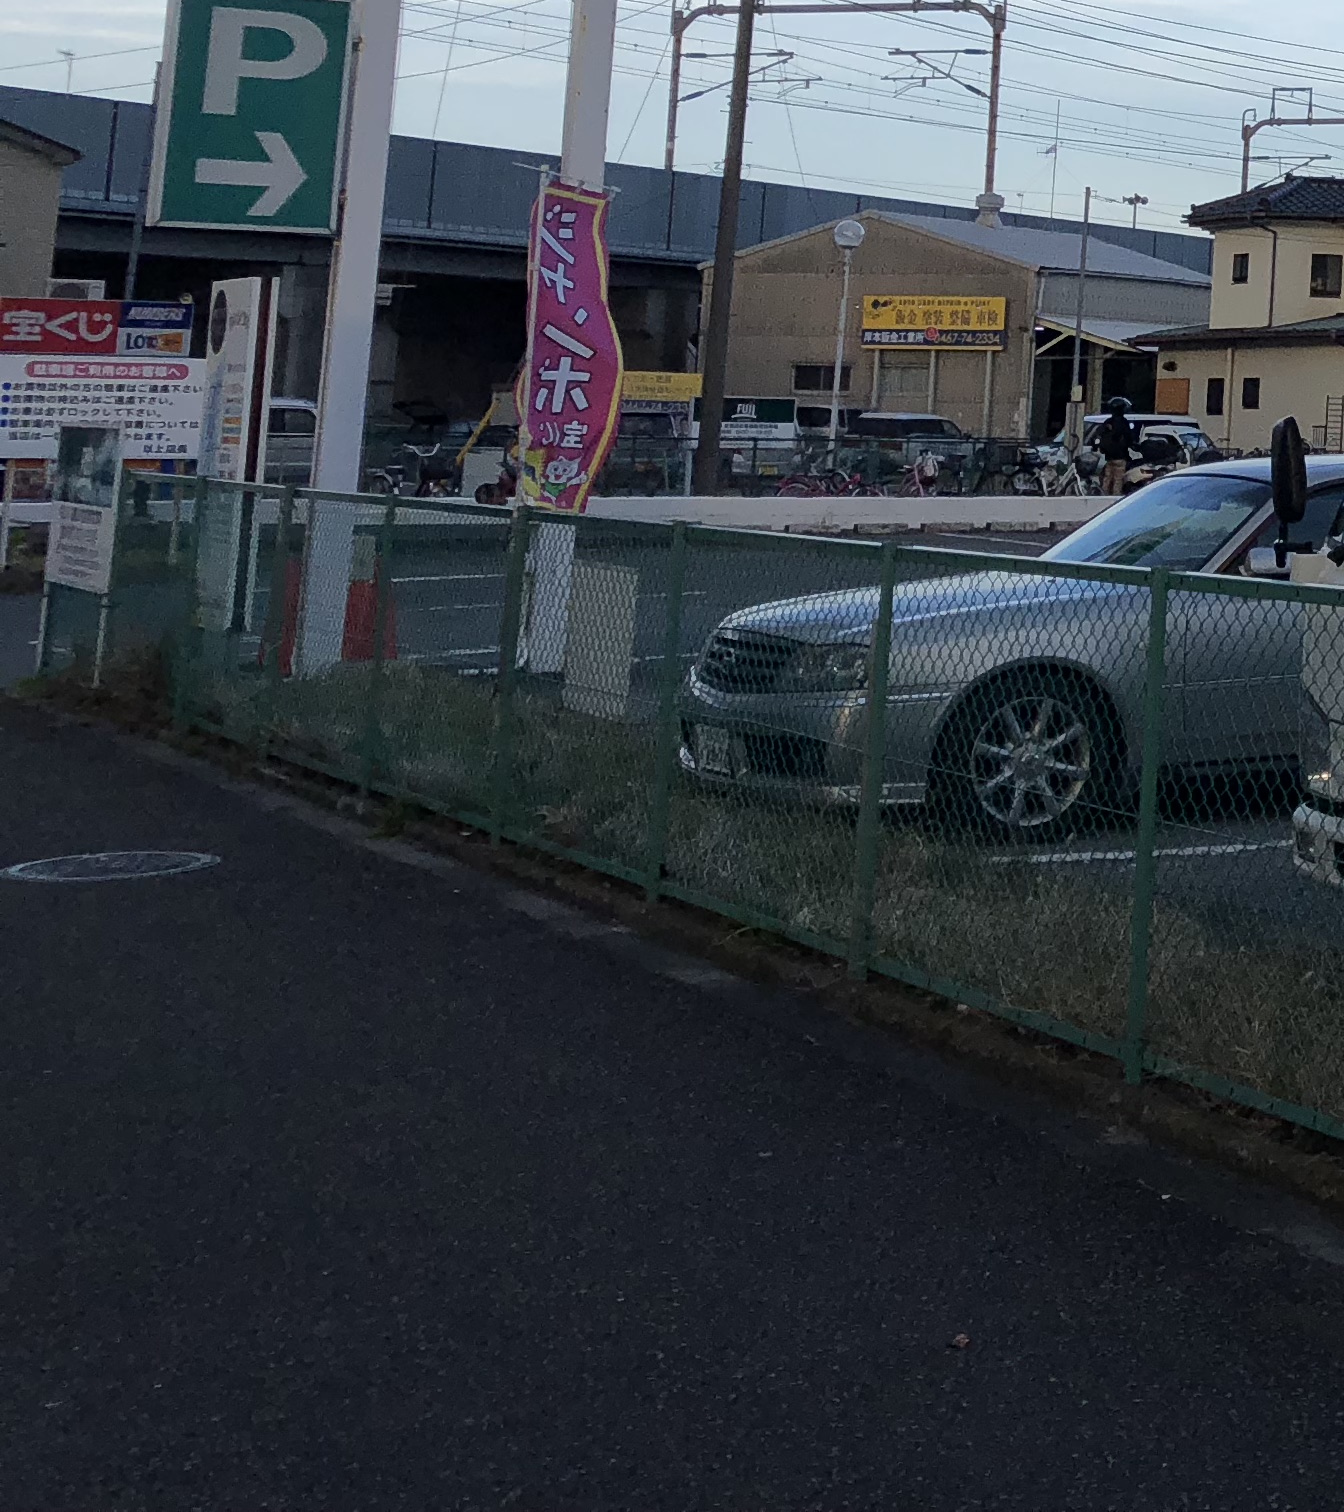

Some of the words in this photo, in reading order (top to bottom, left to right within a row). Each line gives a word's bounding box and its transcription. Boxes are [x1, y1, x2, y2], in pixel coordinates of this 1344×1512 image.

[201, 6, 328, 116] P
[2, 309, 114, 343] 宝くじ
[976, 309, 999, 326] 車検
